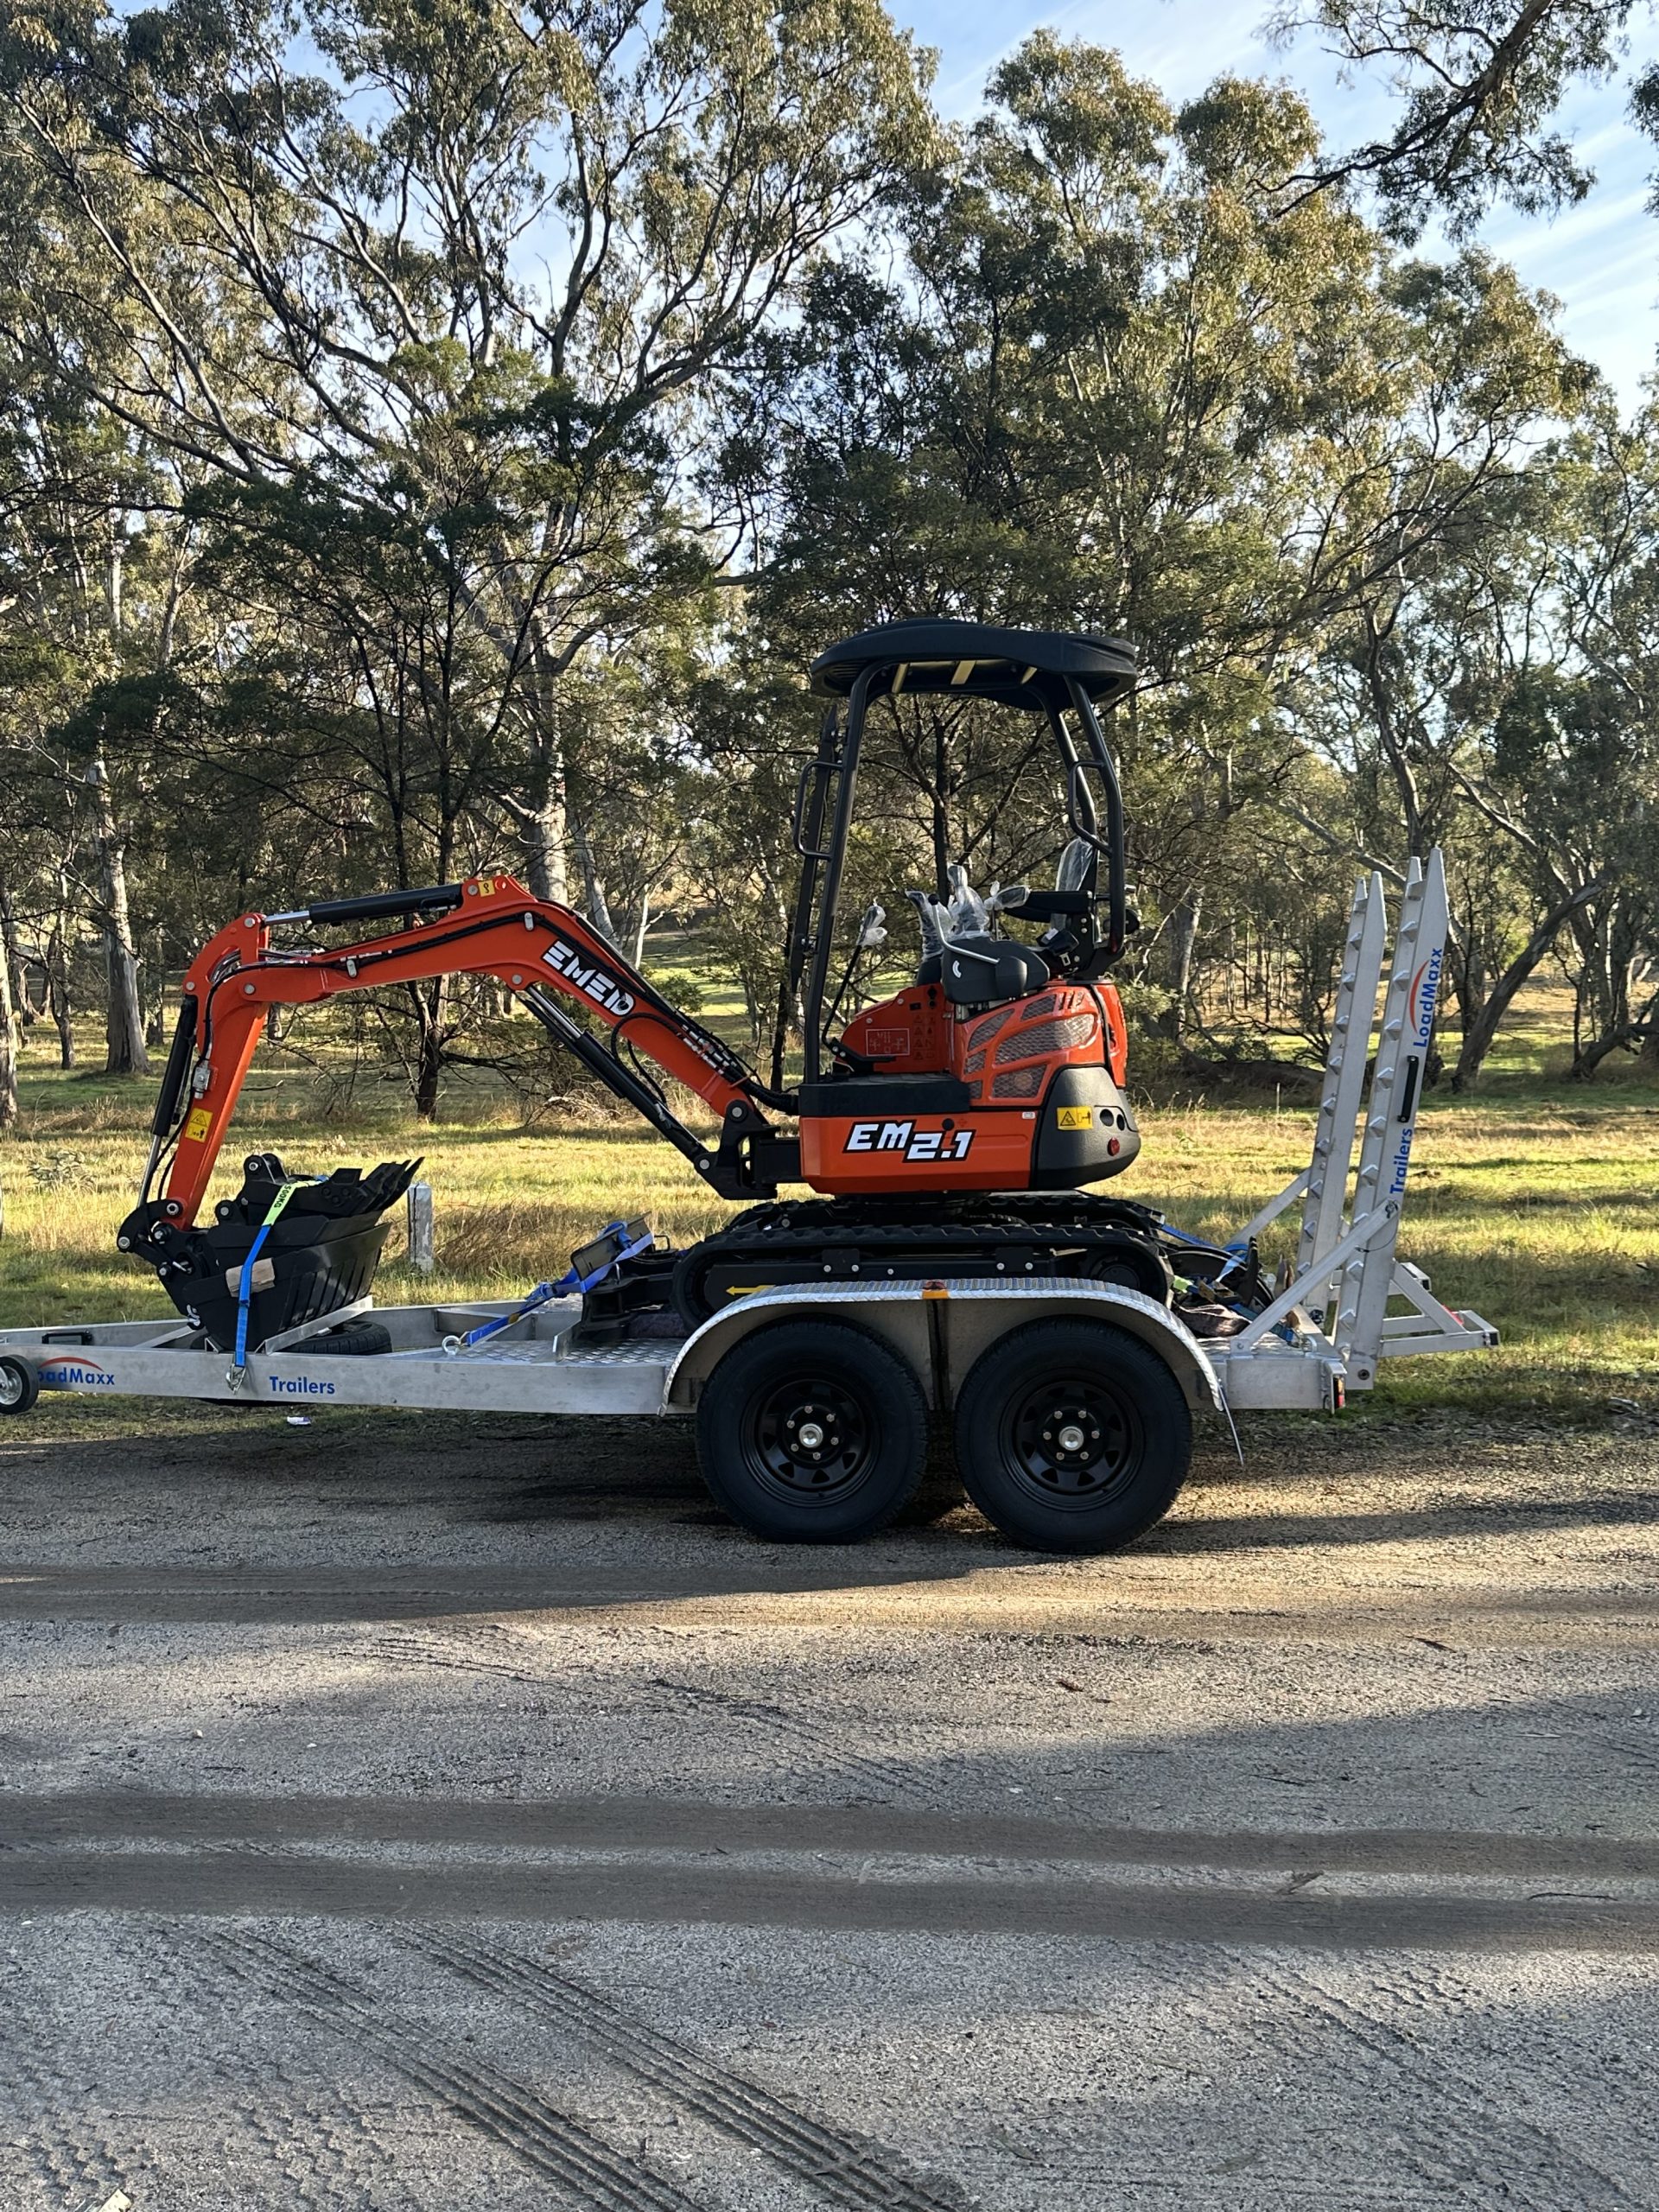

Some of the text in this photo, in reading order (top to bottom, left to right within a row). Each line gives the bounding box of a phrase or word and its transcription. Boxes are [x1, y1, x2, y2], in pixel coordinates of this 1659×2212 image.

[543, 940, 635, 1015] EMED
[1413, 948, 1442, 1047] LoadMaxx
[1389, 1128, 1413, 1193] Trailers
[36, 1367, 116, 1385] oadMaxx
[270, 1376, 335, 1395] Trailers
